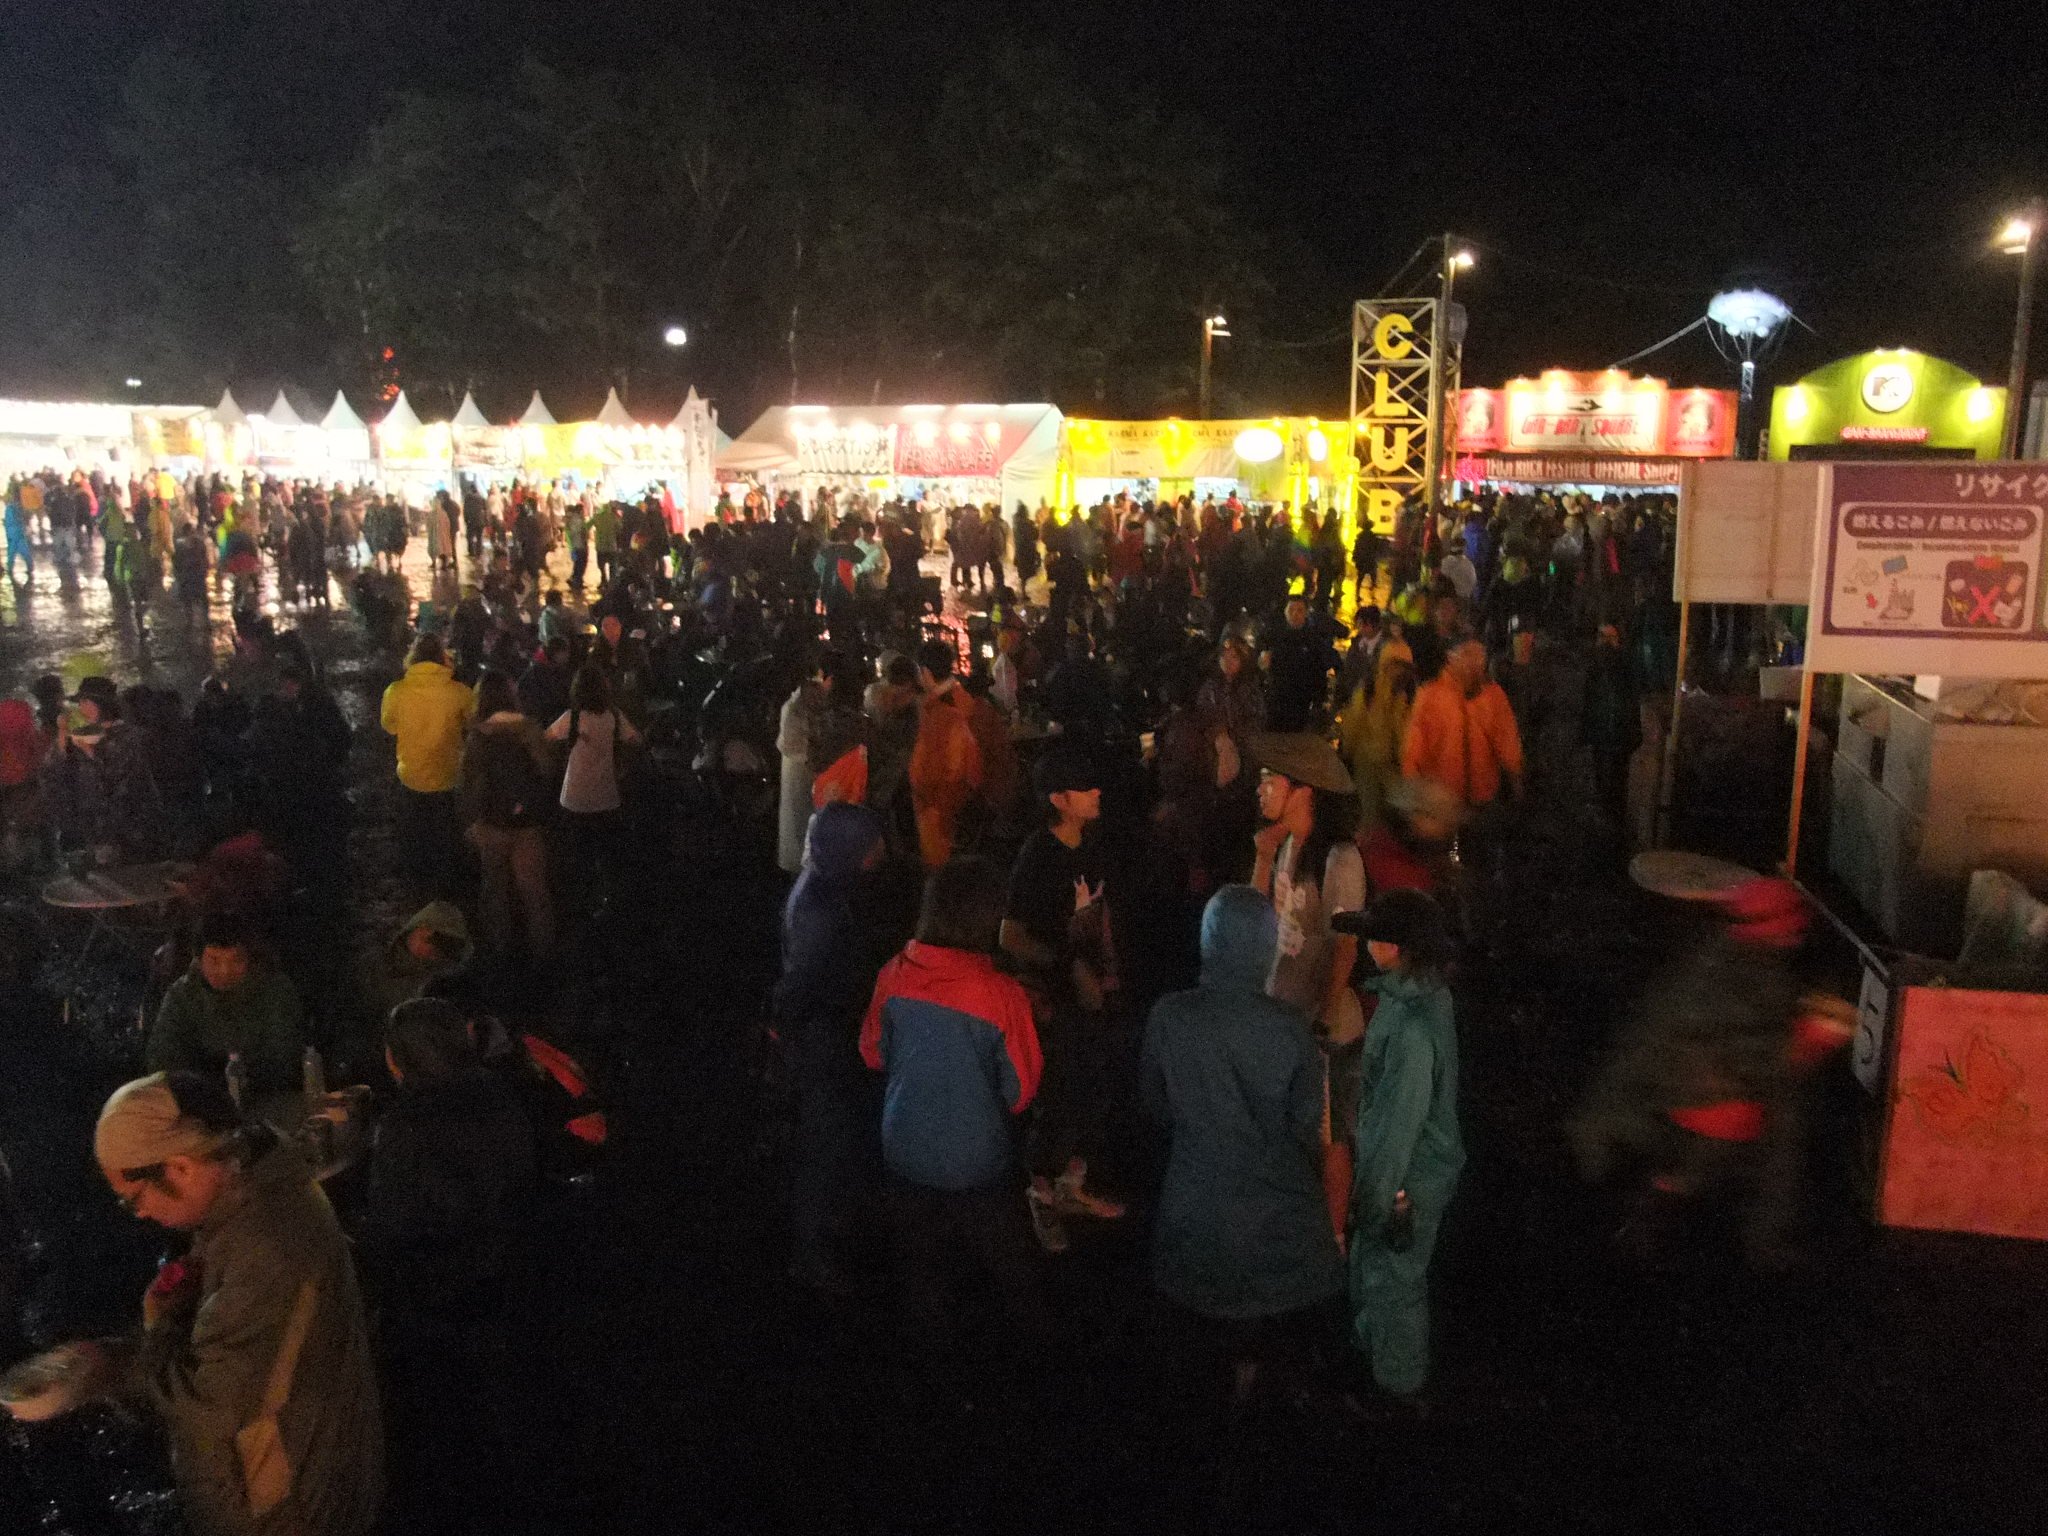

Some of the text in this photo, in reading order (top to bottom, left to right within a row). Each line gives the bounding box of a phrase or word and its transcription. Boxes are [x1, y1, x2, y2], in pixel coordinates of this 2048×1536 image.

[1368, 313, 1413, 535] CLUB
[1515, 460, 1542, 477] ROCK
[1546, 461, 1590, 478] FESTIVAL
[1594, 462, 1639, 479] OFFICIAL
